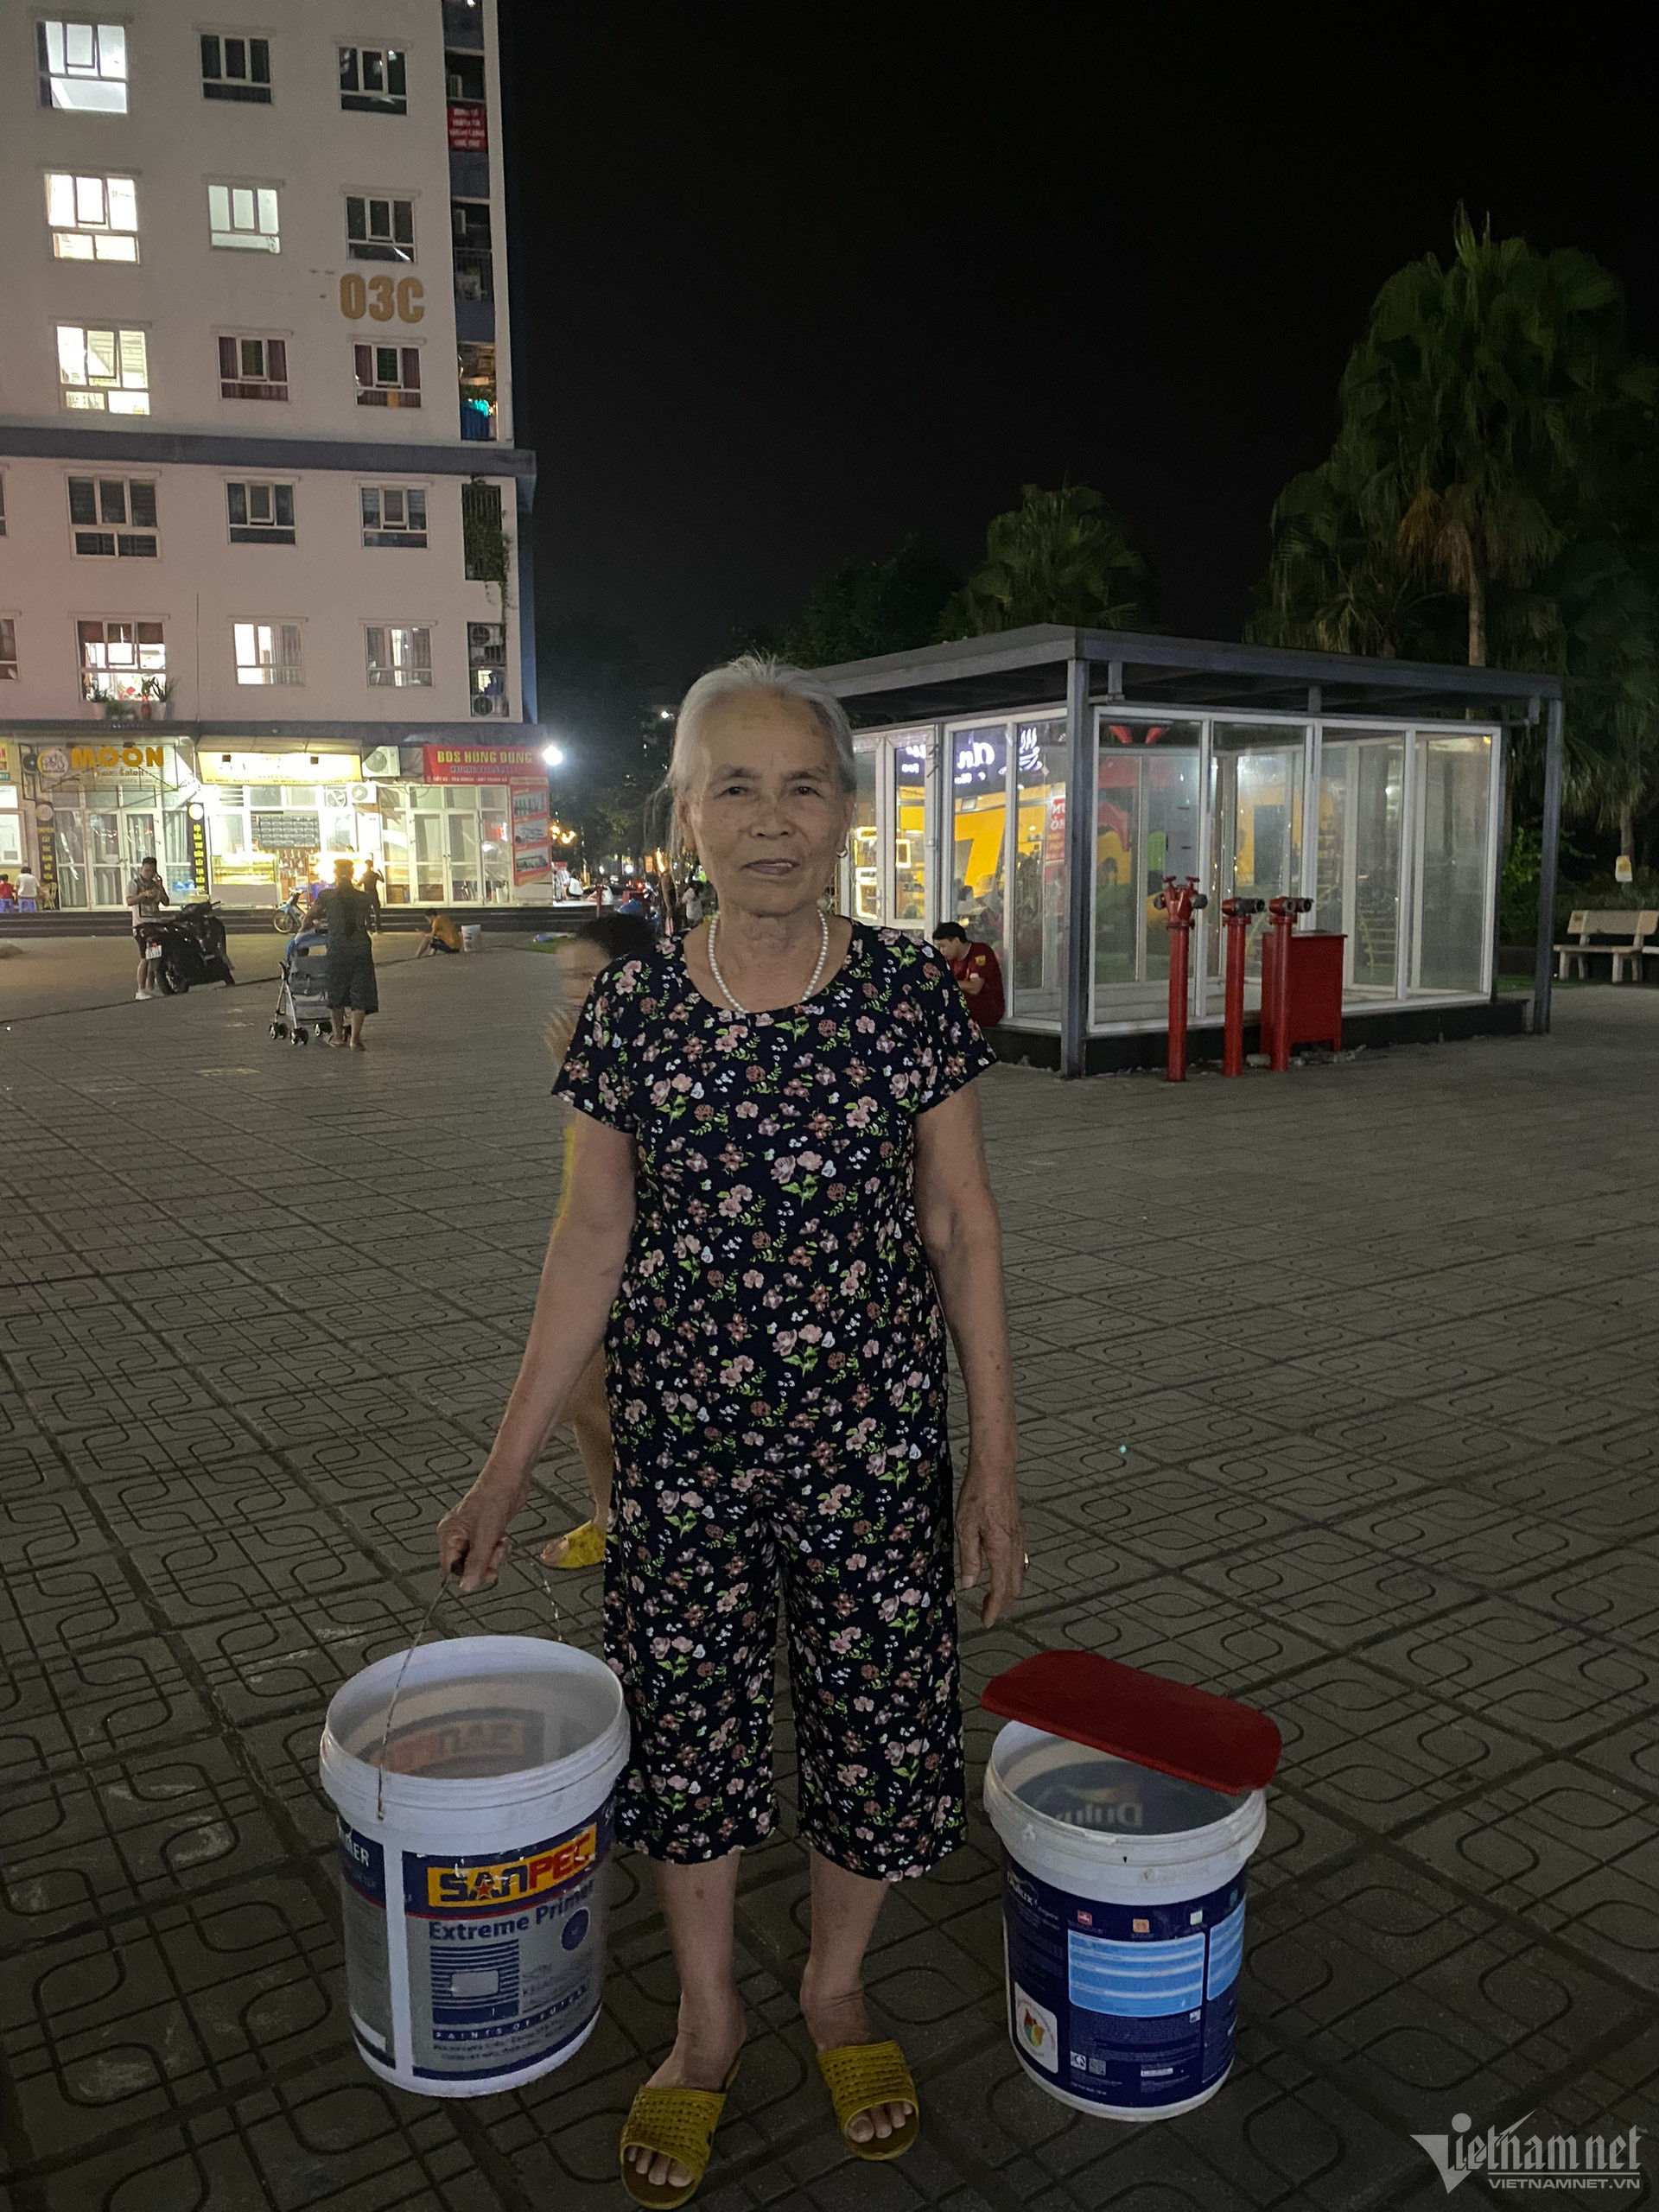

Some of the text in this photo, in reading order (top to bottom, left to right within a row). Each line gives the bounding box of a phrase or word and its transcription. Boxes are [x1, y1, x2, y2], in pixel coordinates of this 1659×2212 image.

[340, 273, 425, 324] 03C
[71, 746, 164, 768] MOON
[429, 1914, 529, 1941] Extreme
[435, 2027, 502, 2039] PAINTS
